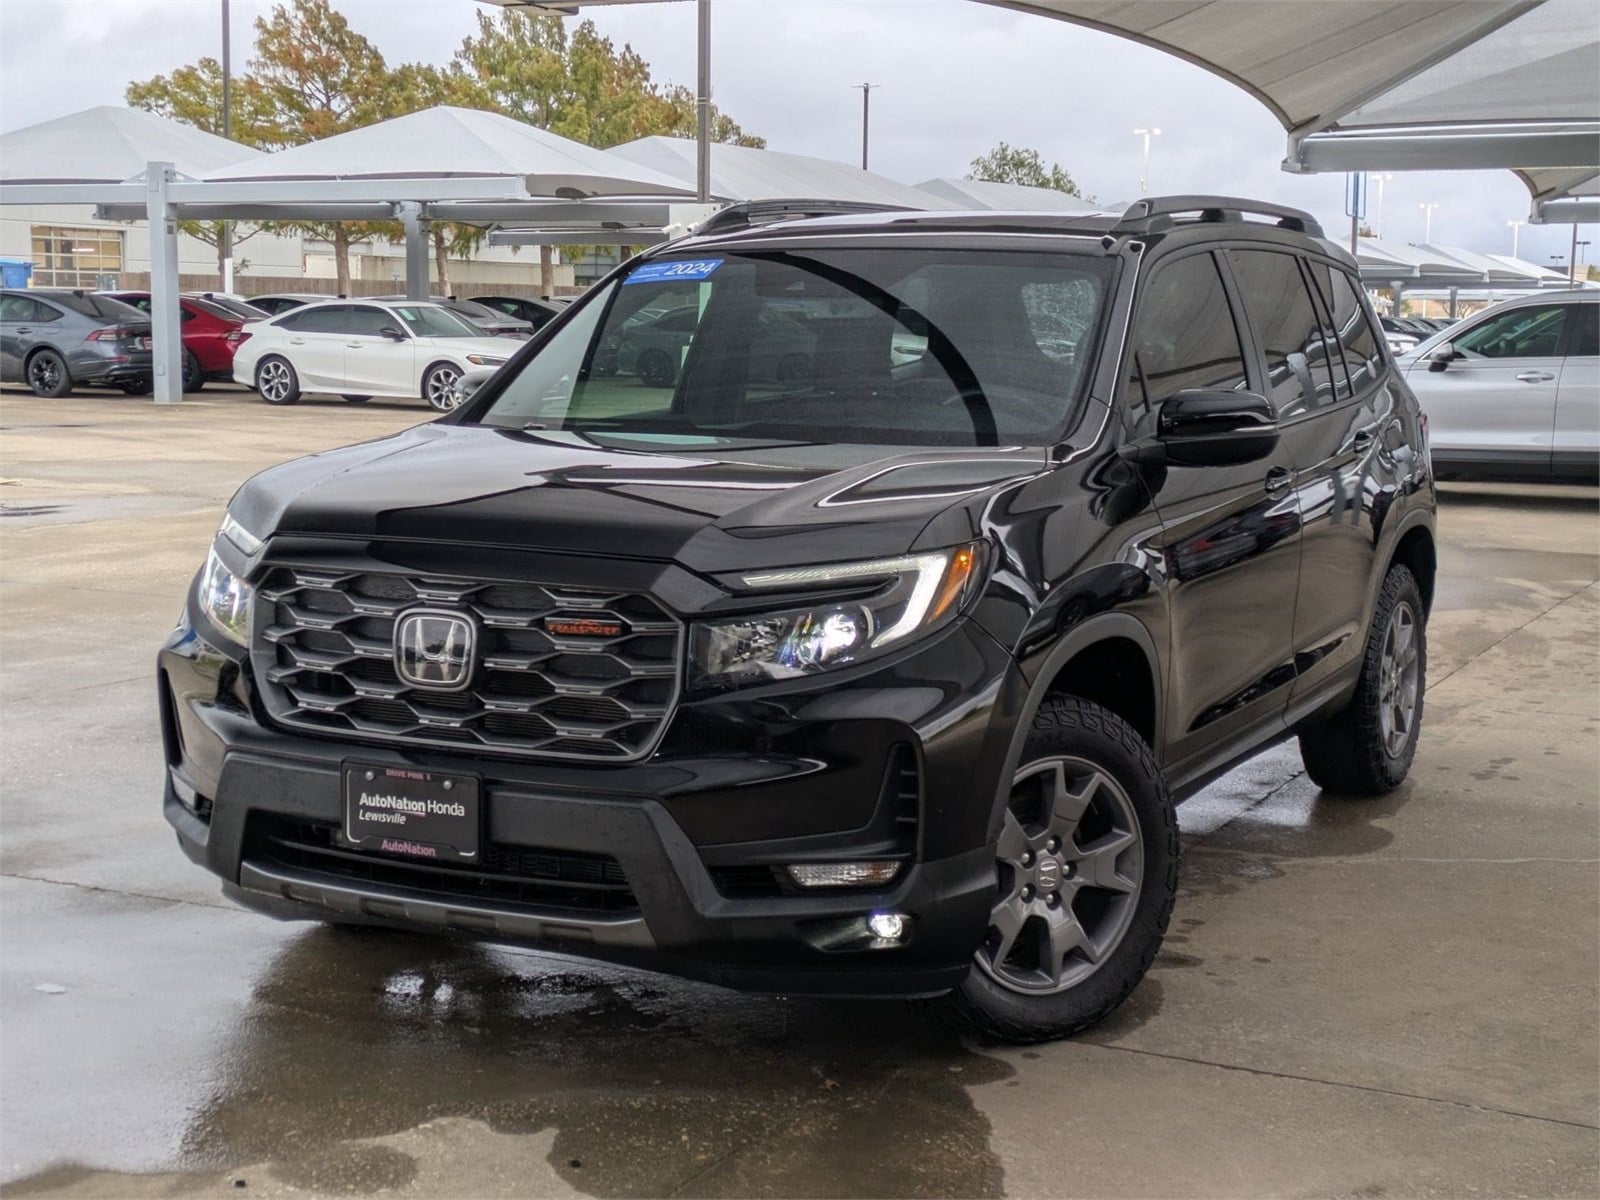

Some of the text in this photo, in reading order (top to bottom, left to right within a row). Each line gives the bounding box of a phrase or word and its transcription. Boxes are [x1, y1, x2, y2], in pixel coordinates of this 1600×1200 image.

[664, 262, 716, 275] 2024
[359, 792, 466, 816] AutoNation Honda
[359, 809, 407, 825] Lewisville
[381, 839, 437, 857] AutoNation
